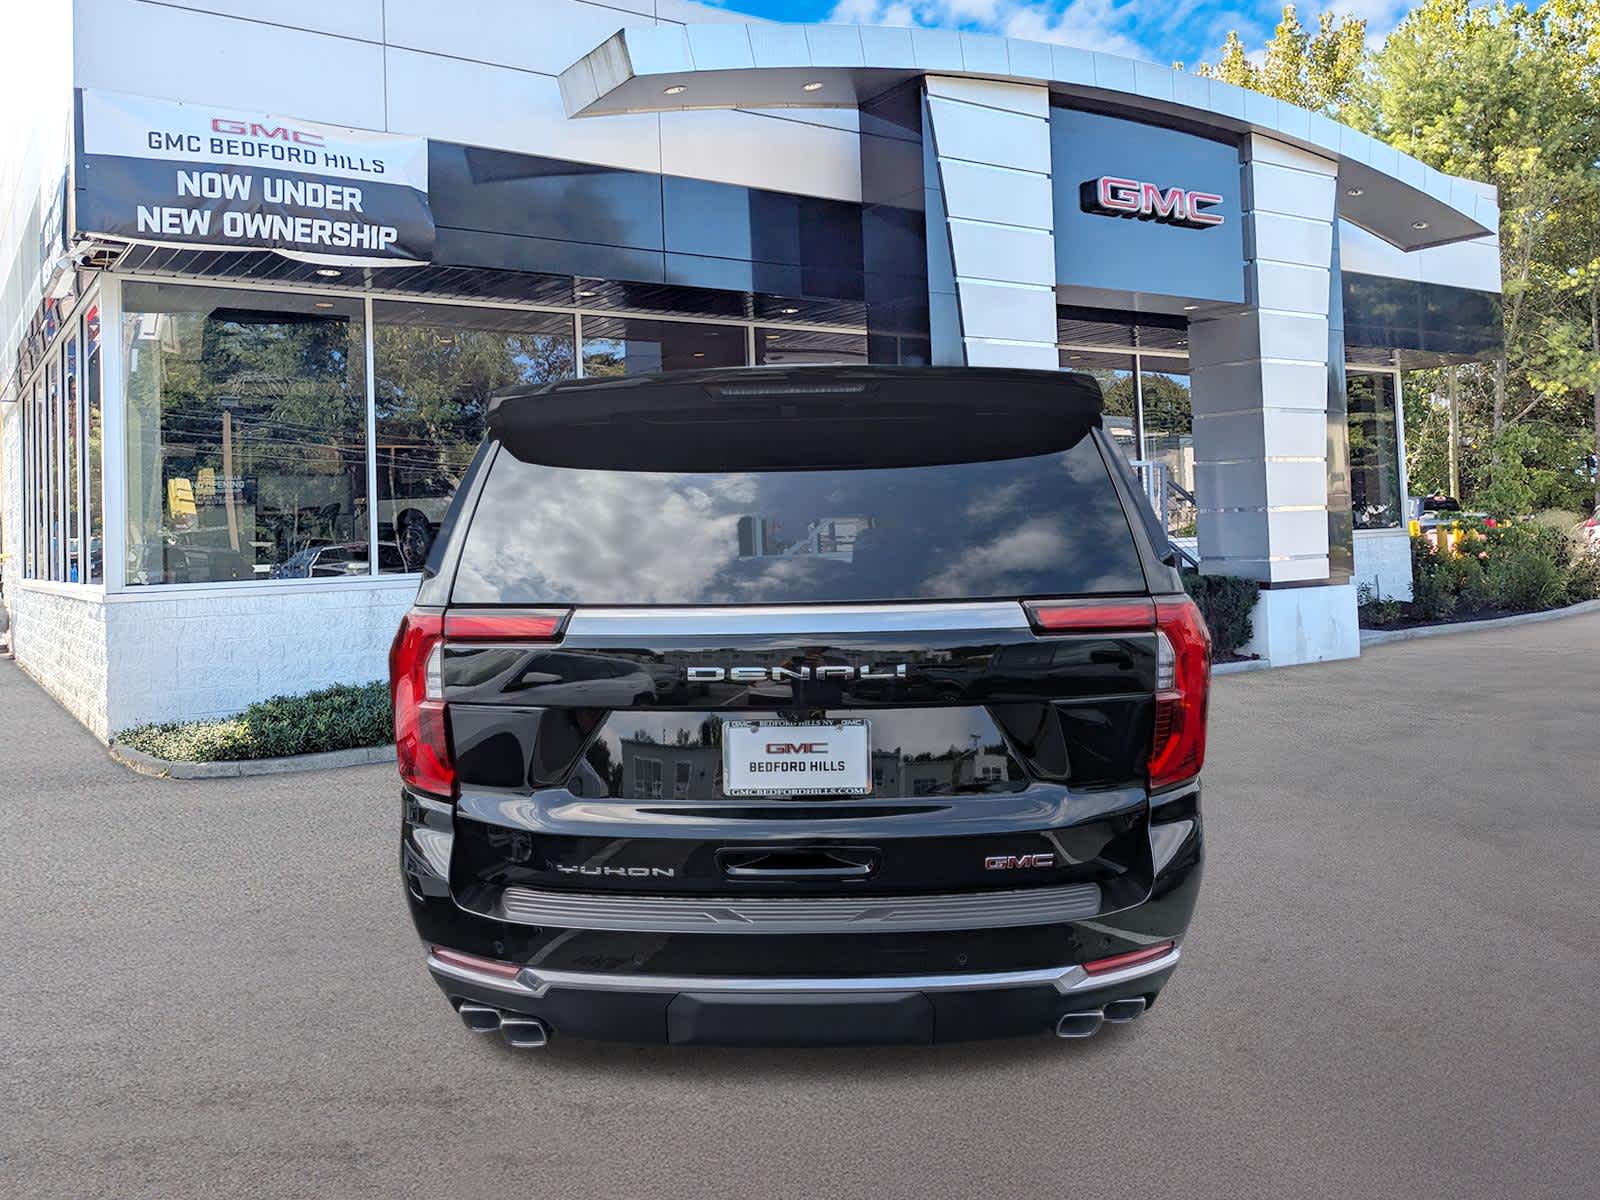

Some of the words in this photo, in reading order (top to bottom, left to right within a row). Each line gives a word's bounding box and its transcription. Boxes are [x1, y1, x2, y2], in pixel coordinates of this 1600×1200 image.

[211, 118, 326, 148] GMC
[148, 131, 201, 152] GMC
[210, 138, 317, 165] BEDFORD
[324, 153, 385, 174] HILLS
[176, 170, 252, 201] NOW
[263, 176, 364, 213] UNDER
[1097, 176, 1225, 225] GMC
[136, 205, 212, 236] NEW
[222, 210, 398, 250] OWNERSHIP
[687, 663, 907, 682] DENALI
[731, 720, 752, 728] GMC
[765, 742, 829, 755] GMC
[750, 761, 806, 773] BEDFORD
[810, 760, 846, 772] HILLS
[731, 787, 864, 796] GMCBEDFORDHILLS.COM
[556, 864, 675, 877] YUKON
[984, 853, 1055, 870] GMC
